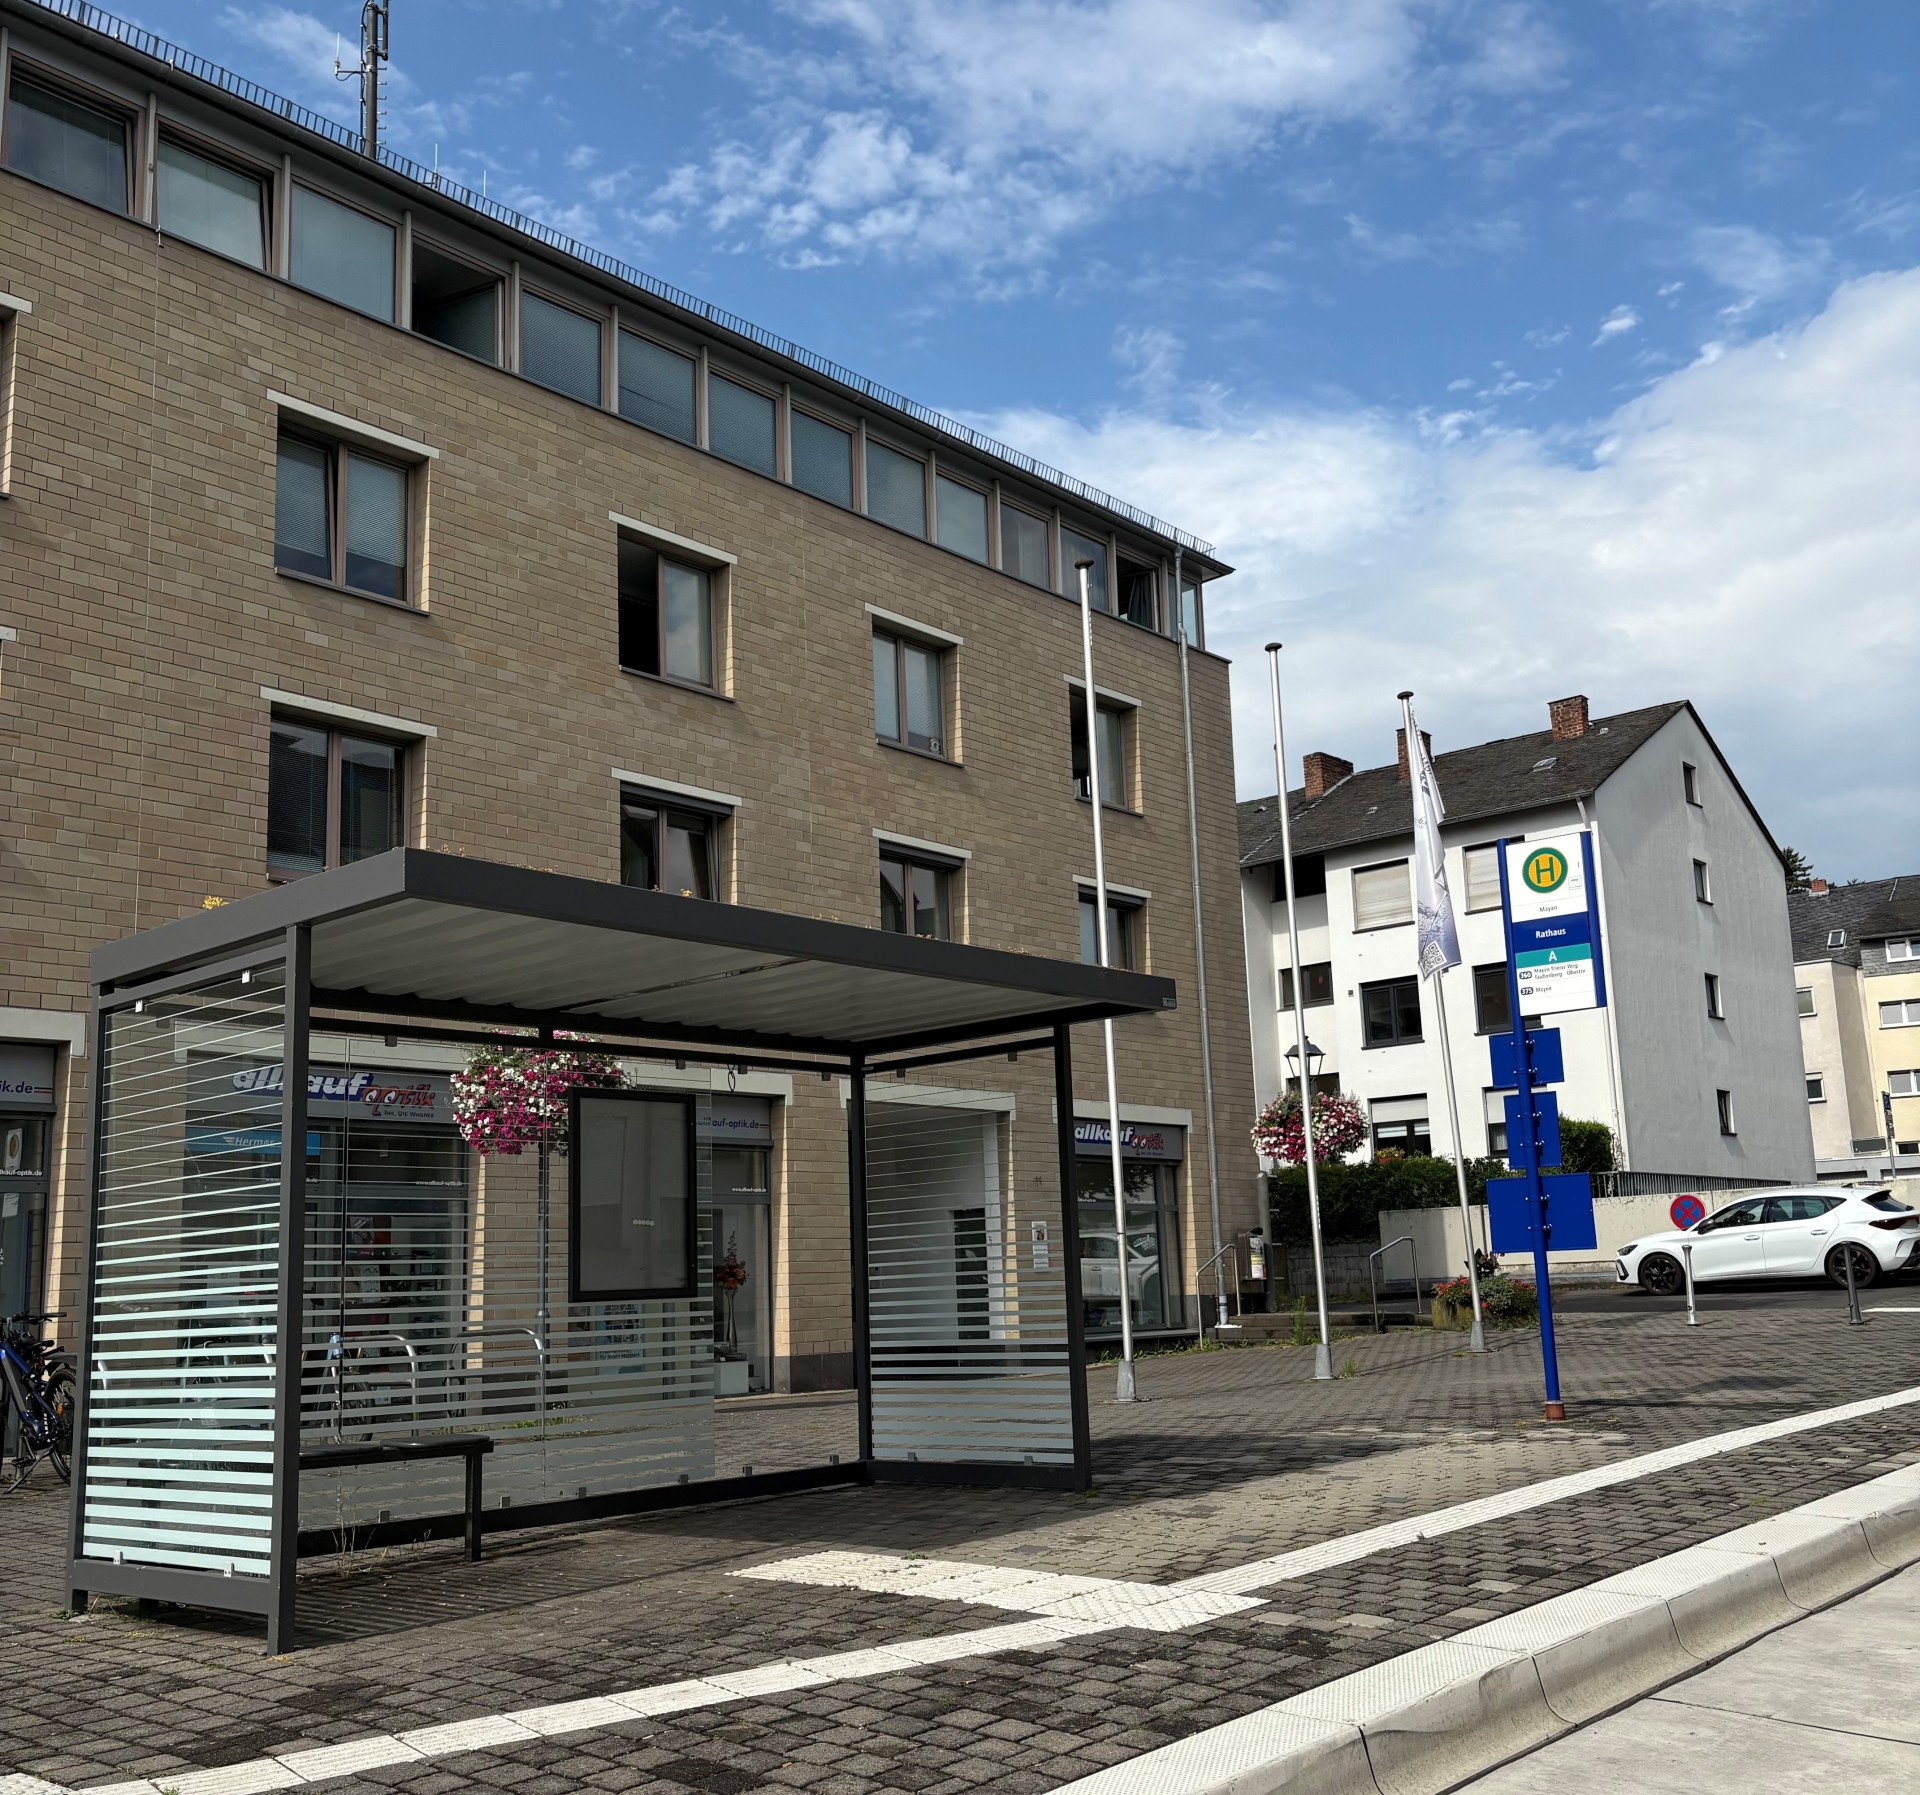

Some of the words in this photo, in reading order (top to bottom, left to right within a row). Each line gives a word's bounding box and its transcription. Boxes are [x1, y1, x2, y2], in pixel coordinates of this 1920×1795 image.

[1535, 928, 1567, 939] Rathaus
[1548, 950, 1558, 961] A
[1521, 988, 1533, 996] 375
[232, 1067, 371, 1098] allauf
[362, 1083, 436, 1116] optik
